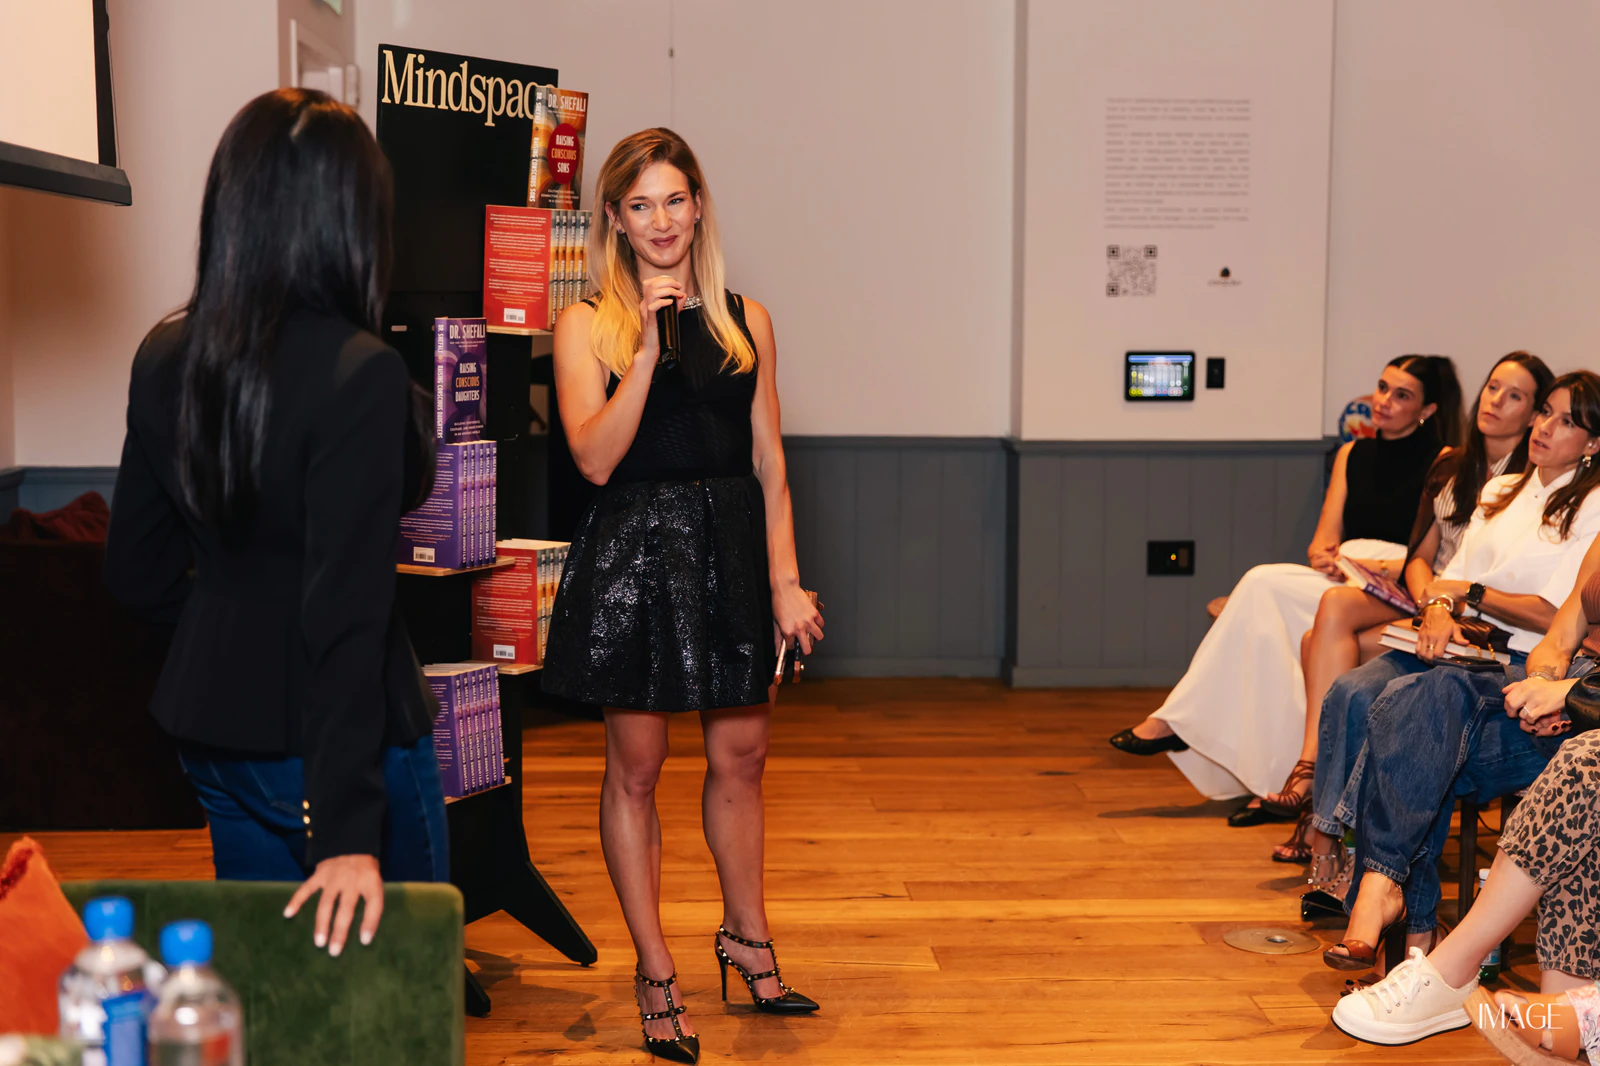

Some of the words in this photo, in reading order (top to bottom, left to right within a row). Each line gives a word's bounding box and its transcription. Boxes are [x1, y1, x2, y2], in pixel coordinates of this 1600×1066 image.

[382, 49, 557, 127] Mindspac
[548, 93, 558, 108] DR.
[560, 96, 587, 112] SHEFALI
[556, 135, 574, 146] RAISING
[551, 148, 576, 160] CONSCIOUS
[530, 159, 538, 187] CONSCIOUS
[557, 162, 570, 173] SONS
[450, 325, 460, 339] DR.
[462, 324, 486, 339] SHEFALI
[460, 363, 476, 373] RAISING
[456, 376, 480, 388] CONSCIOUS
[455, 390, 480, 402] DAUGHTERS
